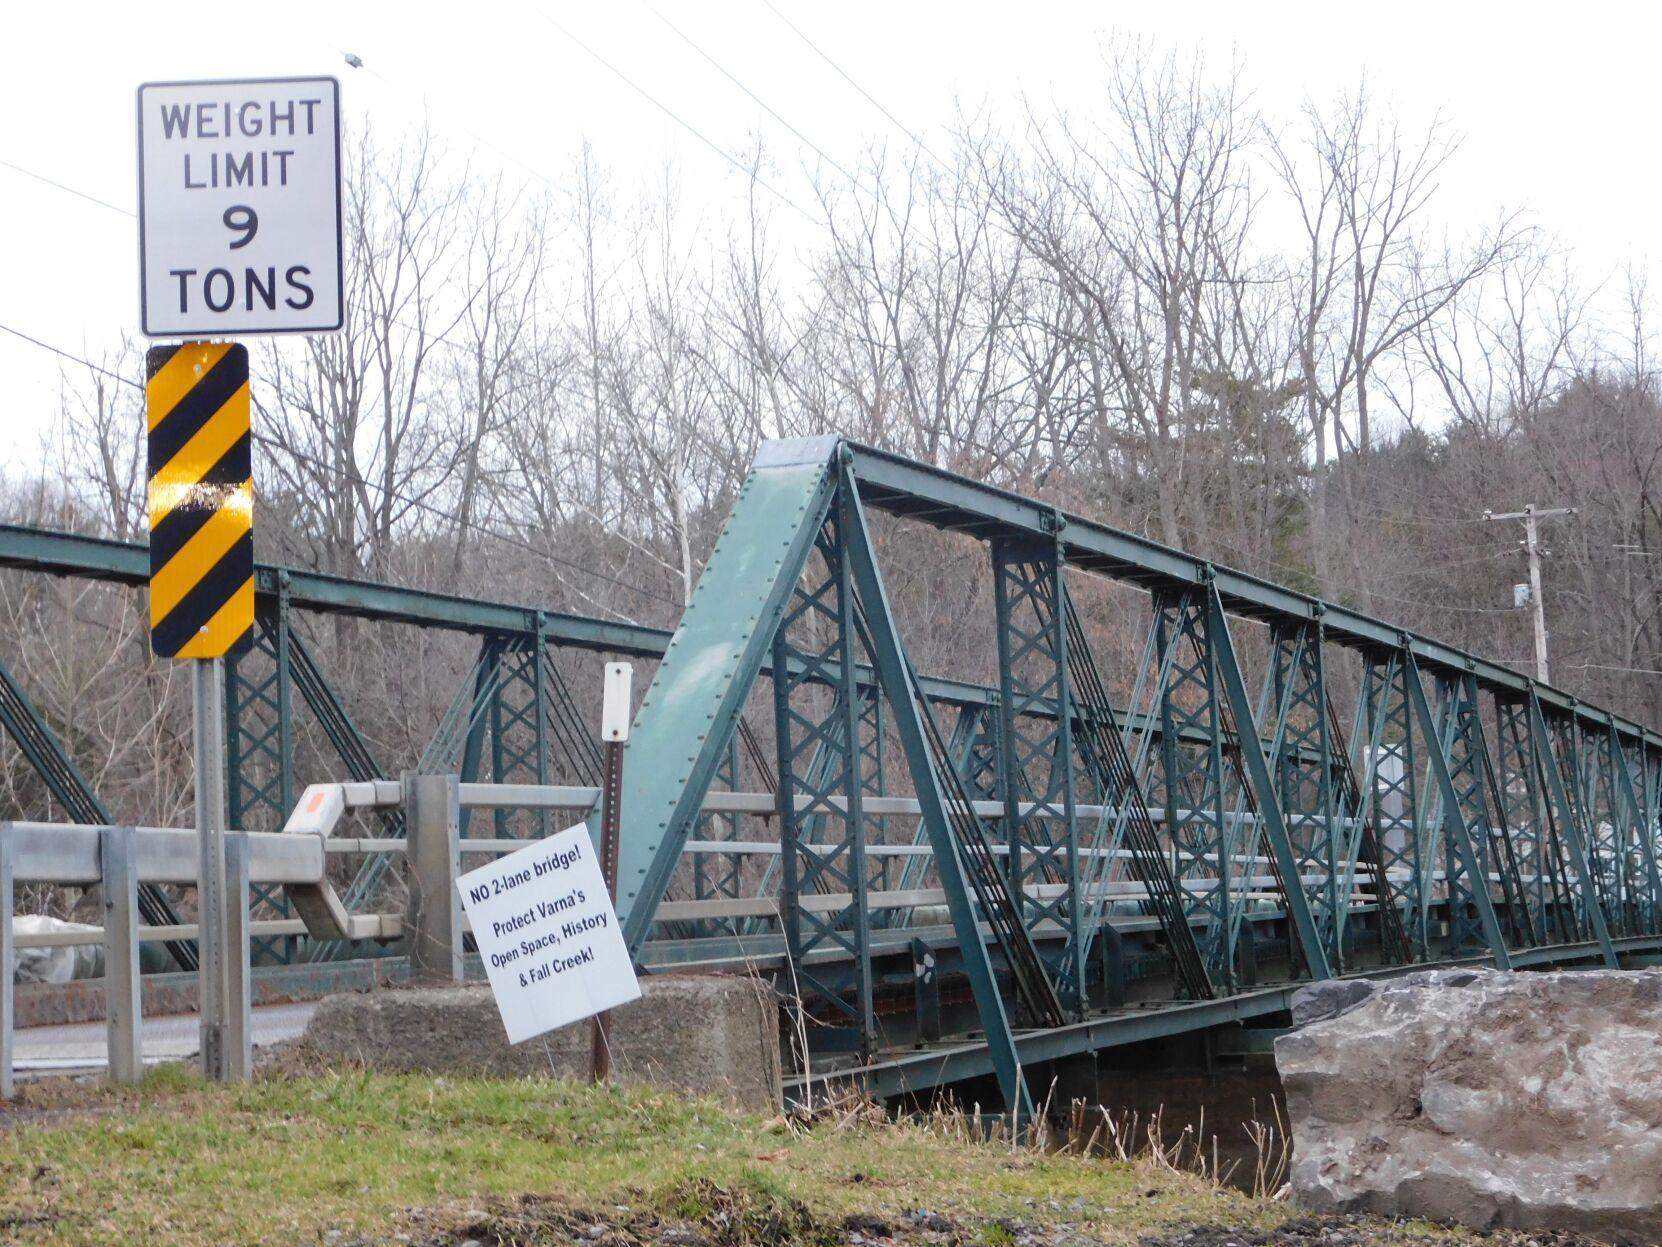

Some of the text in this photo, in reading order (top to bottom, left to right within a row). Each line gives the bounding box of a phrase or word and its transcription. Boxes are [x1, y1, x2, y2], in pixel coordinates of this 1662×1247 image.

[160, 99, 322, 140] WEIGHT
[184, 150, 295, 189] LIMIT
[222, 204, 259, 250] 9
[169, 264, 315, 314] TONS
[469, 844, 582, 905] NO 2-lane bridge!
[492, 889, 586, 938] Protect Varna's
[490, 912, 608, 969] Open Space, History
[518, 946, 595, 988] & Fall Creek!
